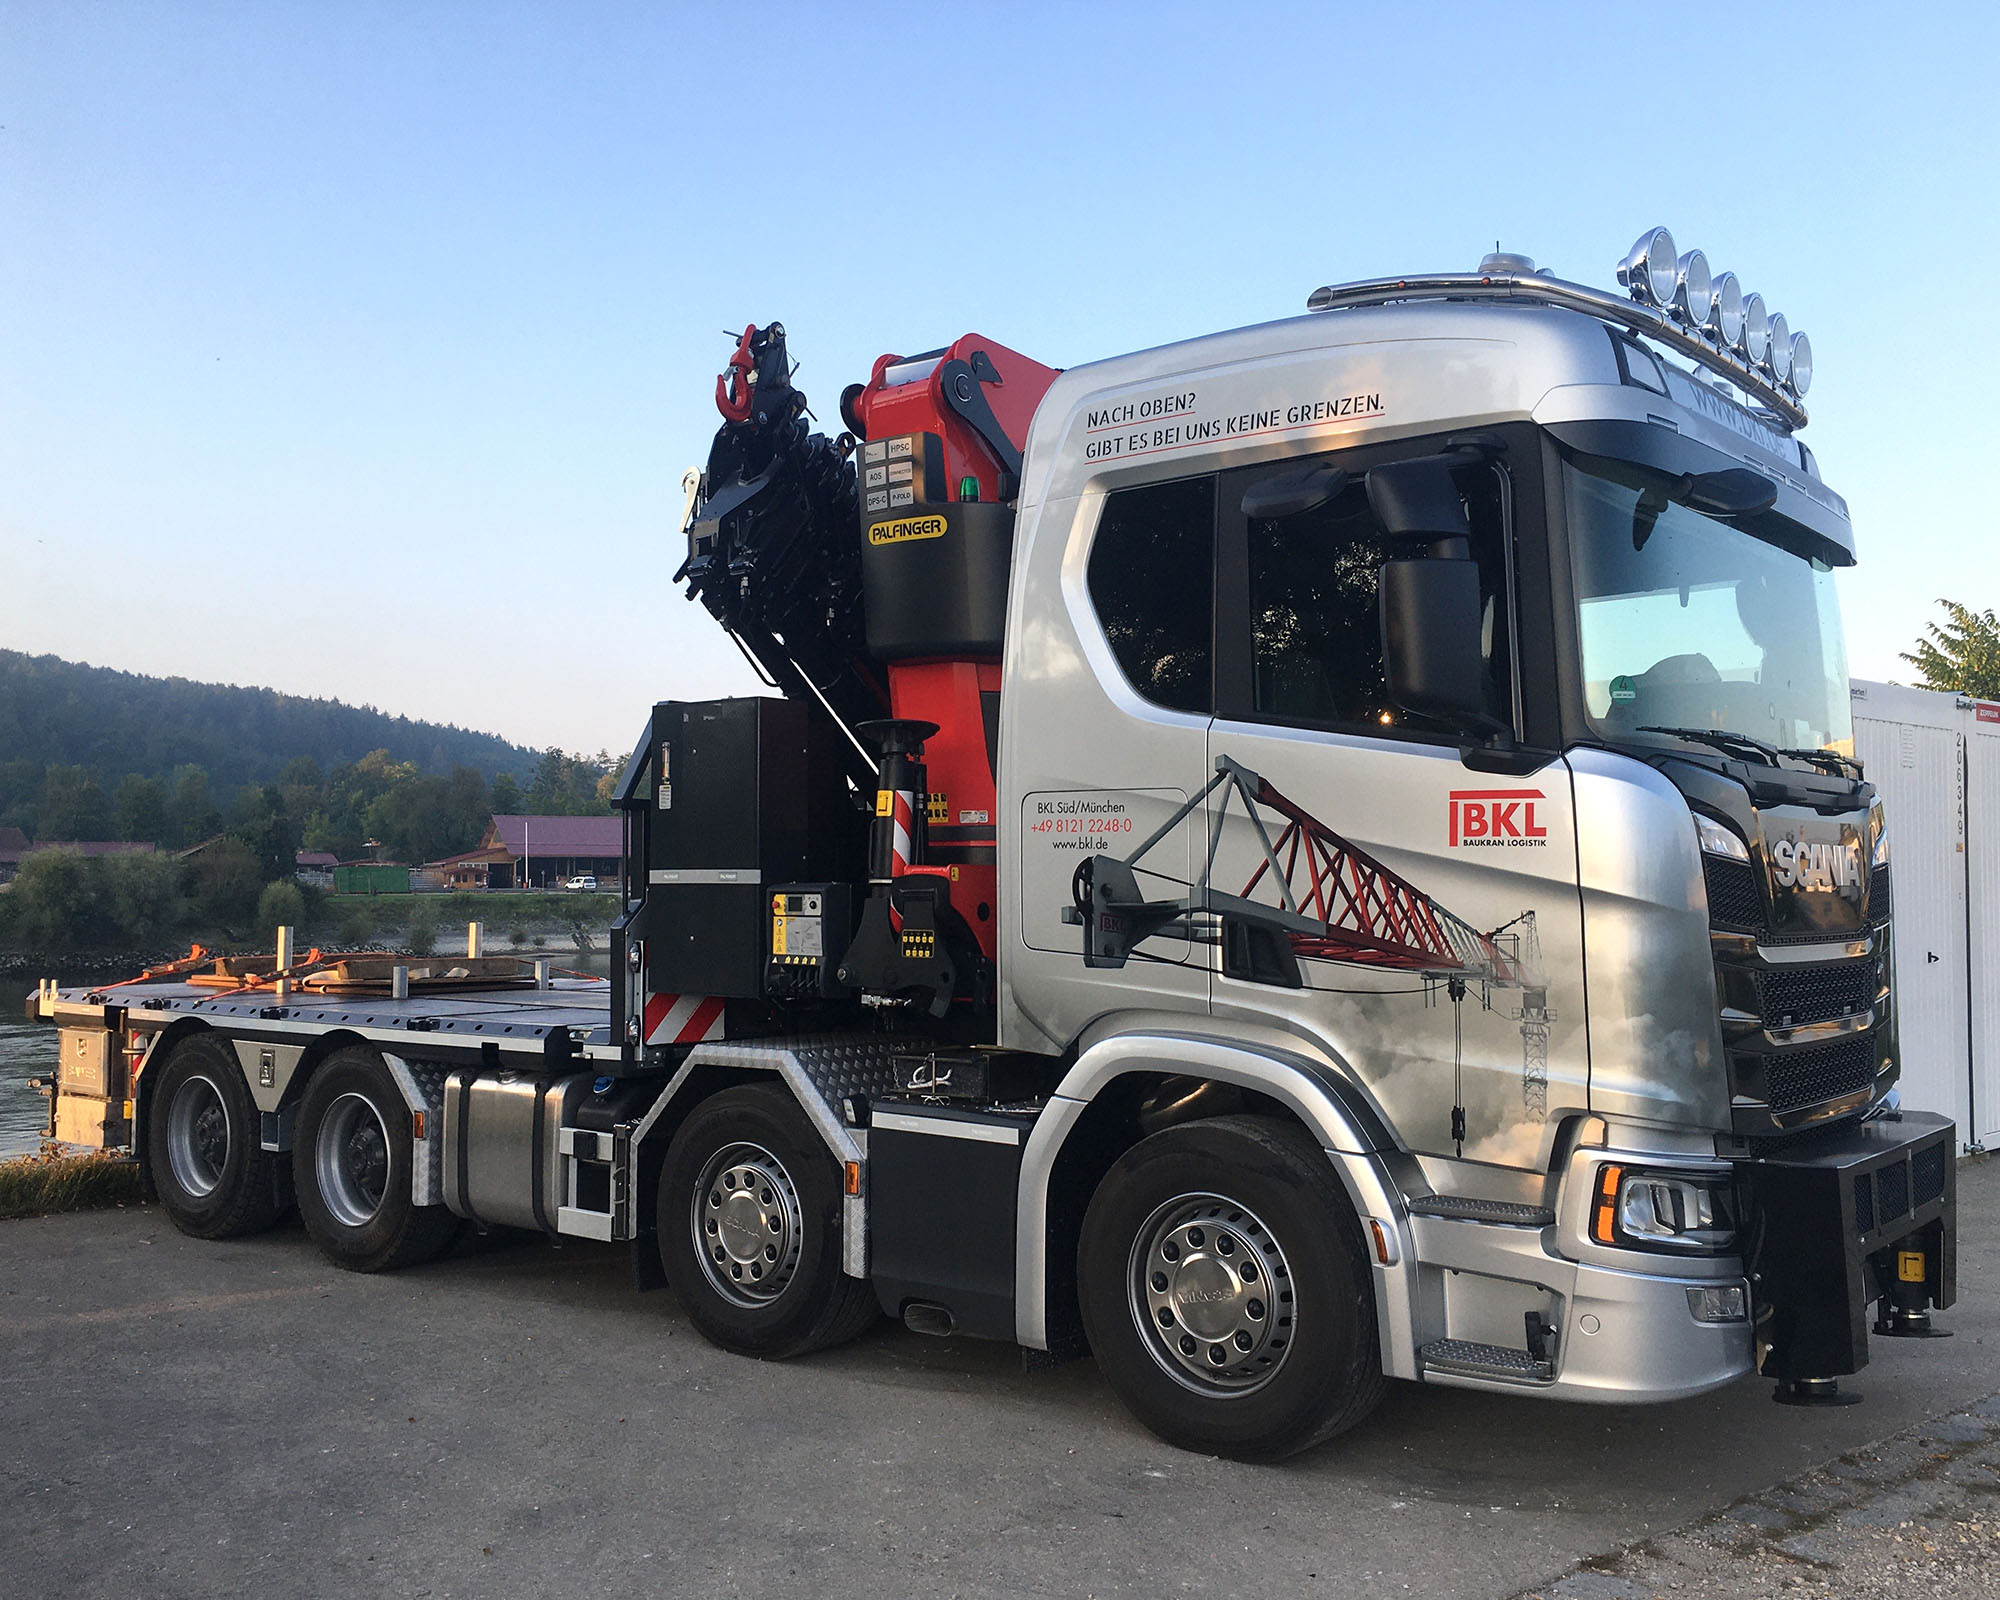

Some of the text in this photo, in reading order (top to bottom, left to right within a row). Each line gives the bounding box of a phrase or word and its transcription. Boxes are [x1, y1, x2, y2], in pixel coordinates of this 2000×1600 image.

[1087, 392, 1196, 429] NACH OBEN?
[1085, 393, 1385, 459] GIBT ES BEI UNS KEINE GRENZEN.
[890, 443, 910, 453] HPSC
[869, 471, 882, 481] AOS
[872, 519, 941, 541] PALFINGER
[1037, 800, 1125, 814] BKL Süd/München
[1031, 818, 1133, 833] +49 8121 2248-0
[1463, 802, 1547, 838] BKL
[1053, 836, 1109, 850] www.bkl.de
[1463, 839, 1547, 847] BAUKRAN LOGISTIK
[1774, 840, 1861, 888] SCANIA
